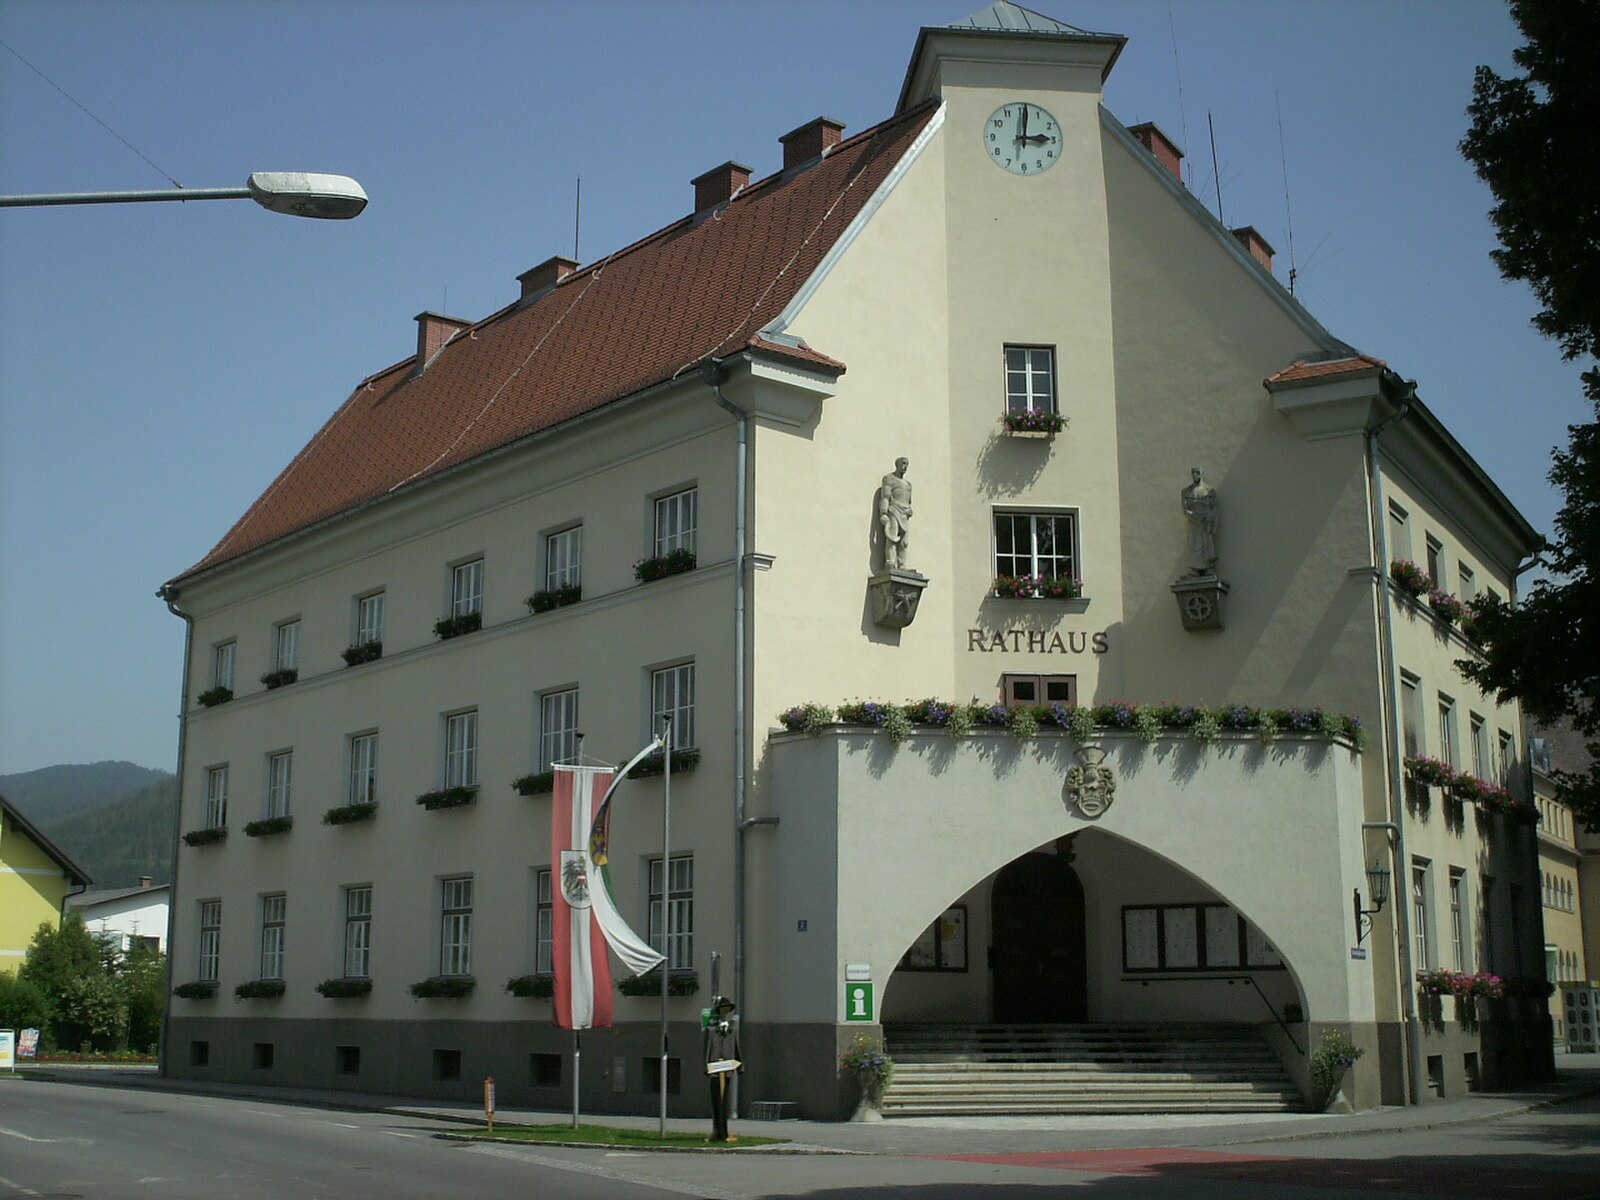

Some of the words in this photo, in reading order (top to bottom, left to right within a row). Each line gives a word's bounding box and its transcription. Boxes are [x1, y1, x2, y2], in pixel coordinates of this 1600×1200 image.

[1003, 109, 1011, 118] 11
[993, 119, 1003, 128] 10
[1046, 122, 1052, 130] 2
[989, 133, 996, 141] 9
[1050, 136, 1056, 144] 3
[994, 147, 1001, 156] 8
[1047, 150, 1053, 158] 4
[1005, 158, 1012, 167] 7
[1036, 160, 1042, 168] 5
[1021, 163, 1027, 171] 6
[967, 629, 1109, 654] RATHAUS
